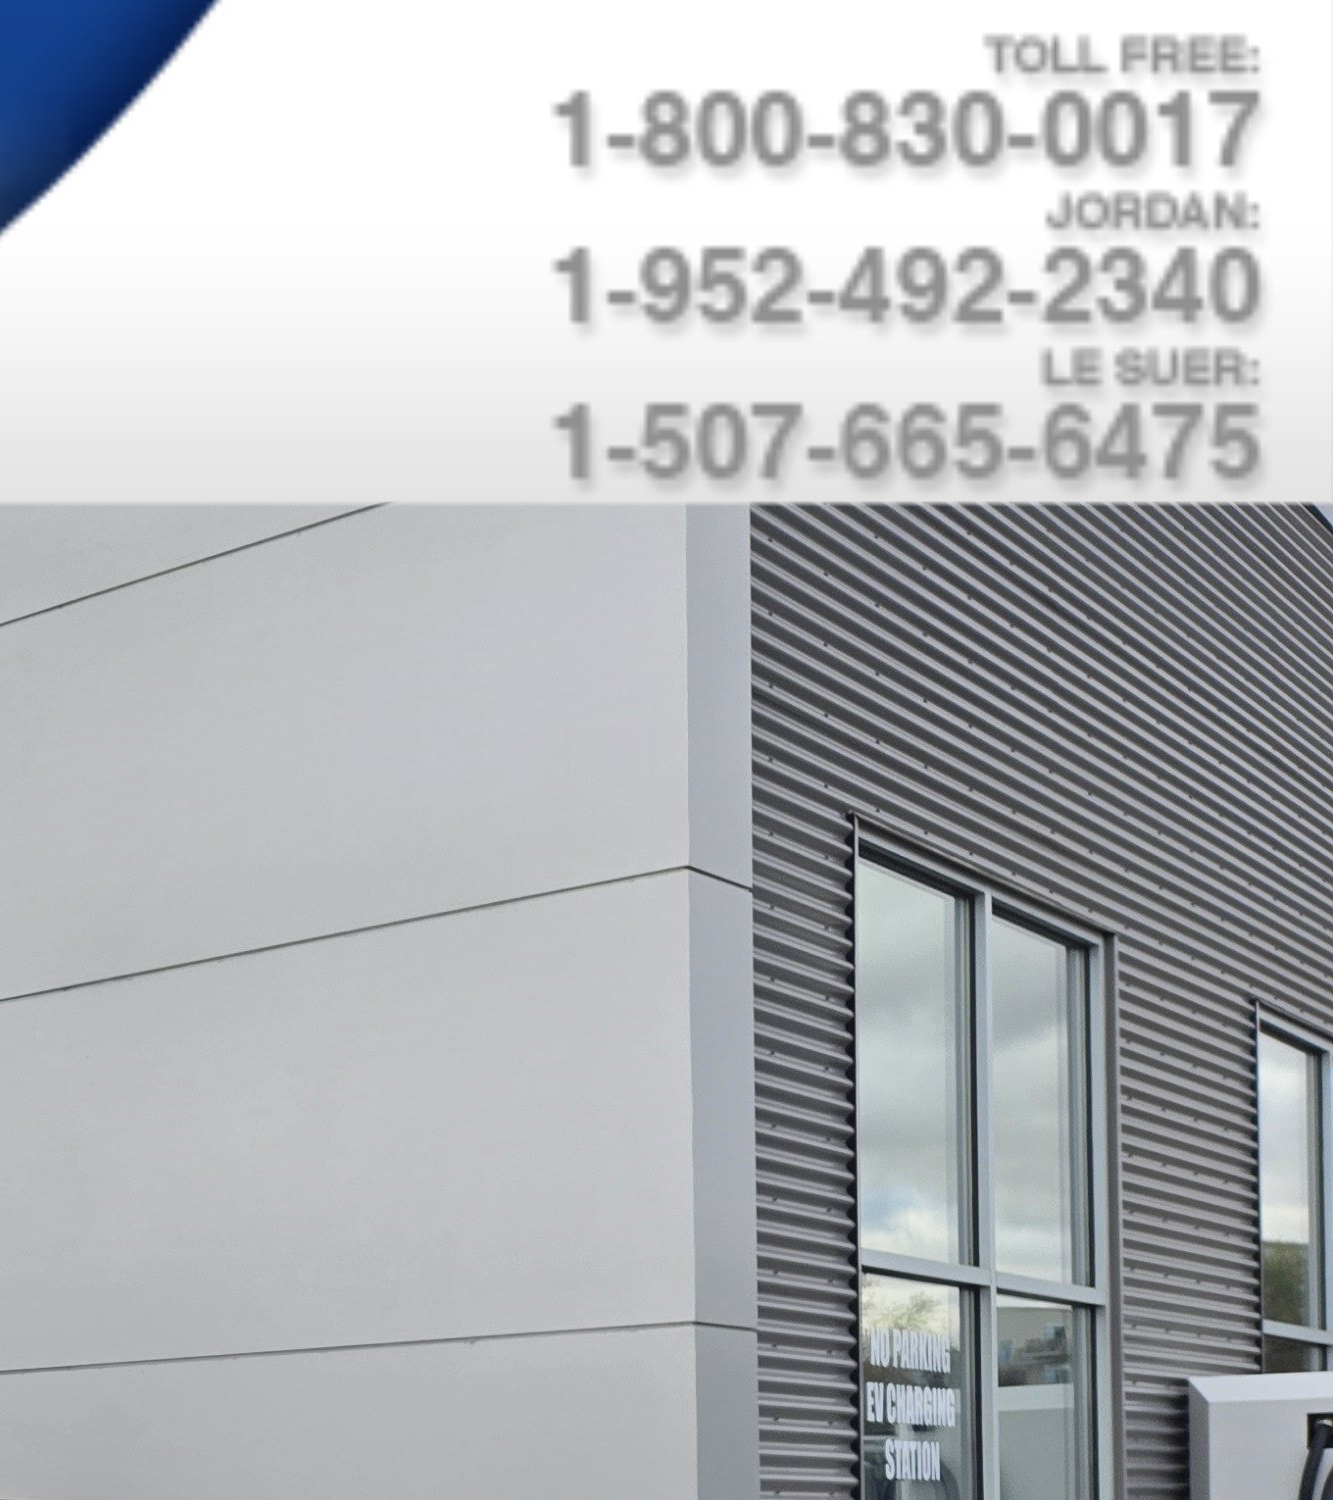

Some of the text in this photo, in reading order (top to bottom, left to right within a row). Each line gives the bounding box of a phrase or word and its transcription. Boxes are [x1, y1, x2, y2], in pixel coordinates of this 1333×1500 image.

[870, 1327, 951, 1373] NO PARKING
[866, 1381, 955, 1426] EV CHARGING
[885, 1439, 941, 1481] STATION
